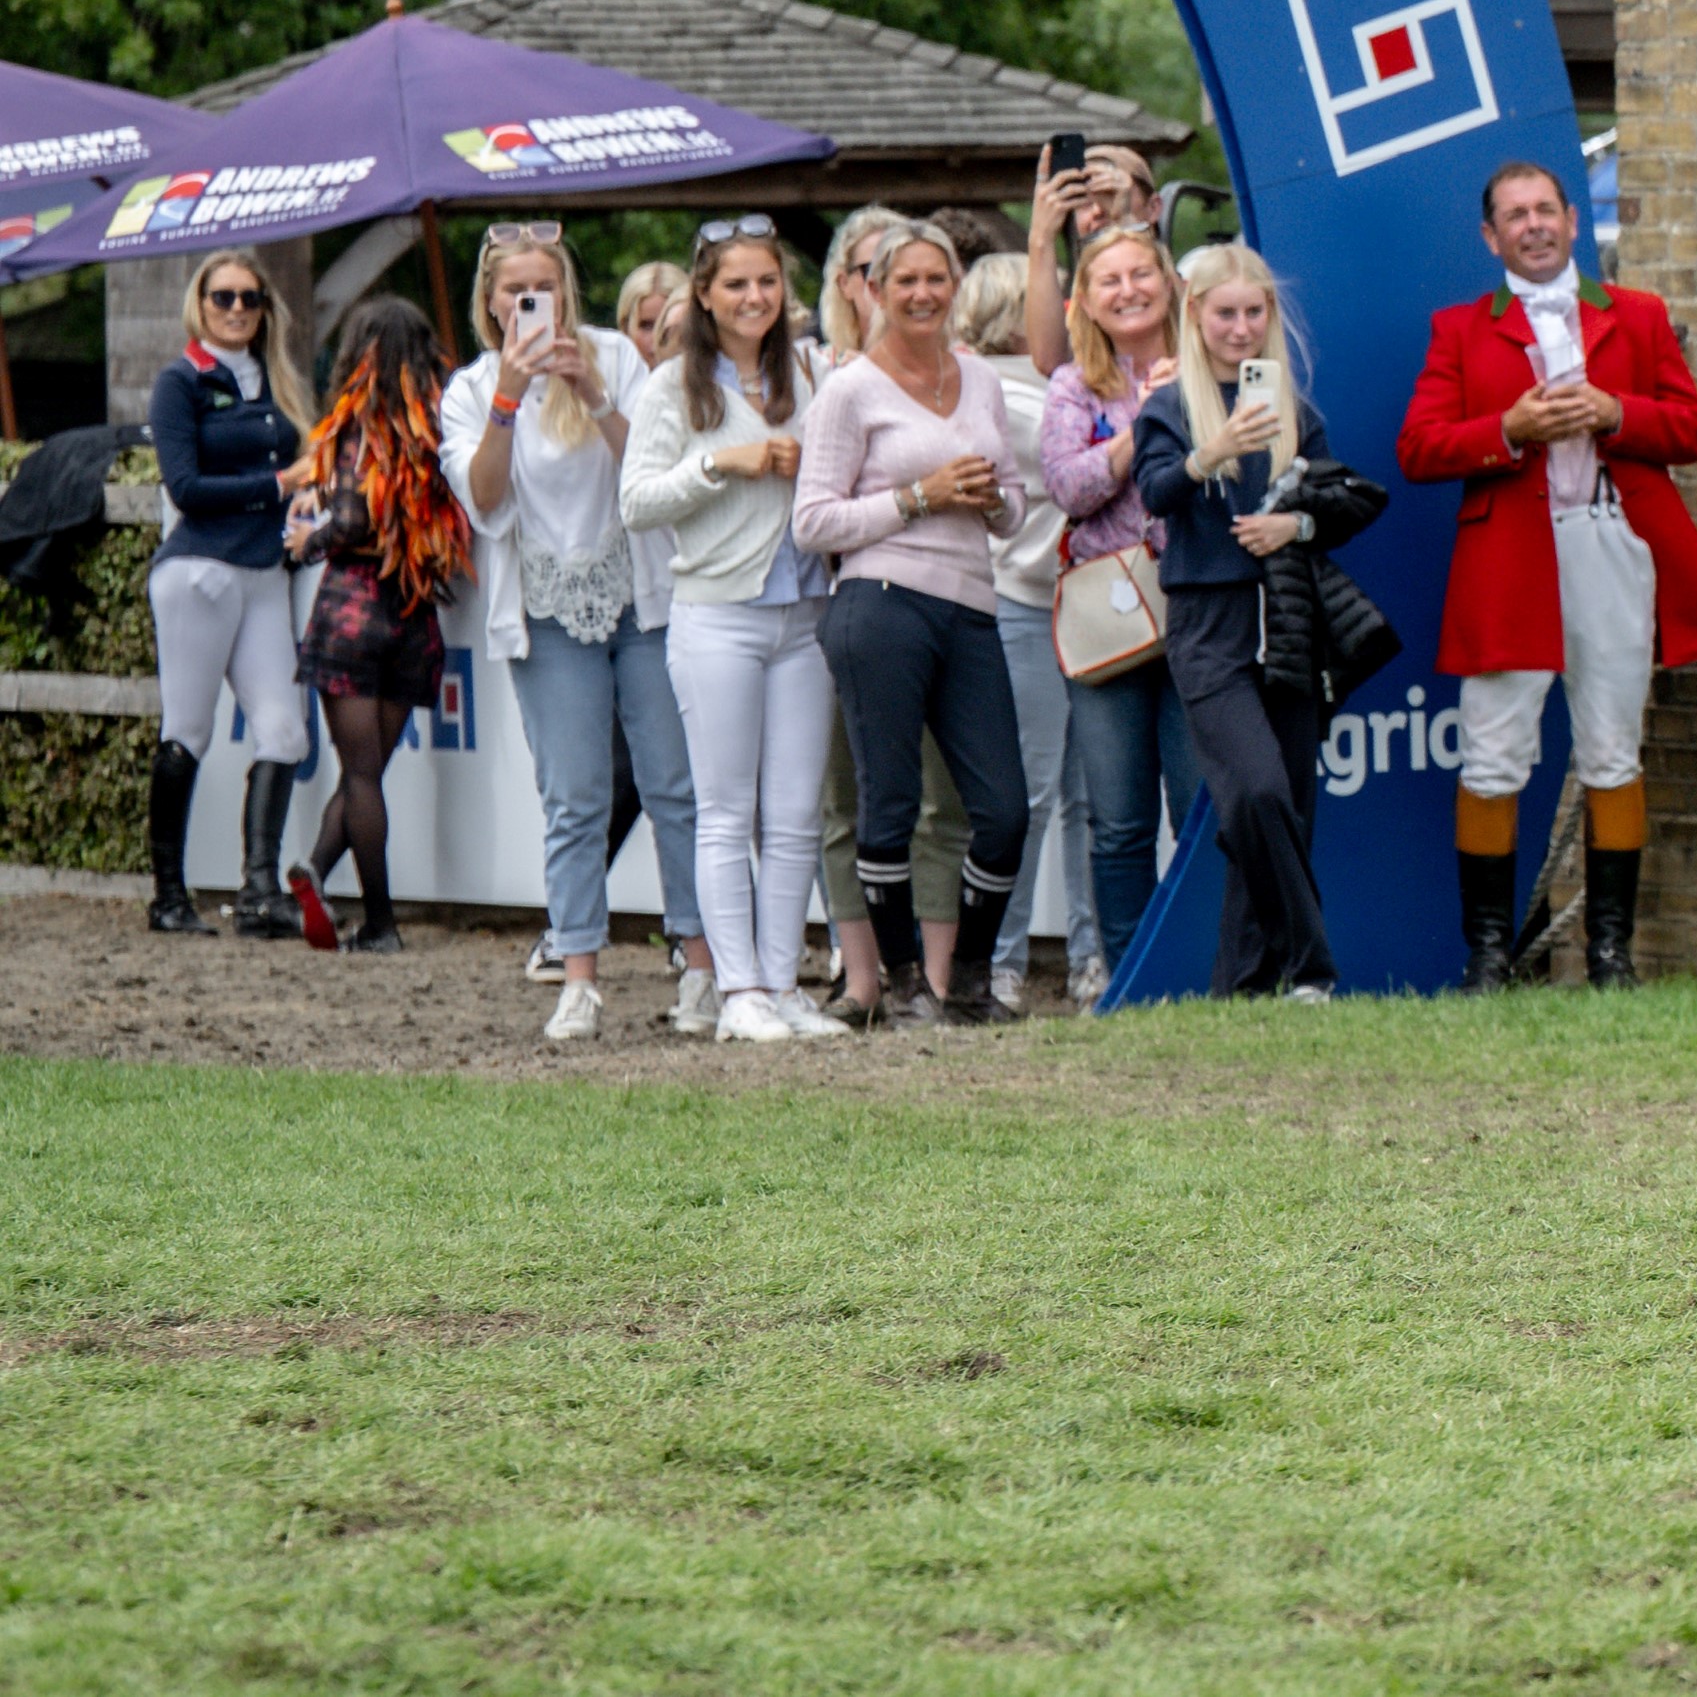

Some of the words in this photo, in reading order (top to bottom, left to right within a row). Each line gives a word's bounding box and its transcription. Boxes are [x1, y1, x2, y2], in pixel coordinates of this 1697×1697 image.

[529, 105, 700, 144] ANDREWS
[0, 146, 102, 173] OWEN
[550, 130, 683, 163] BOWEN
[205, 155, 377, 196] ANDREWS
[189, 189, 320, 225] BOWEN
[1316, 684, 1464, 797] gria
